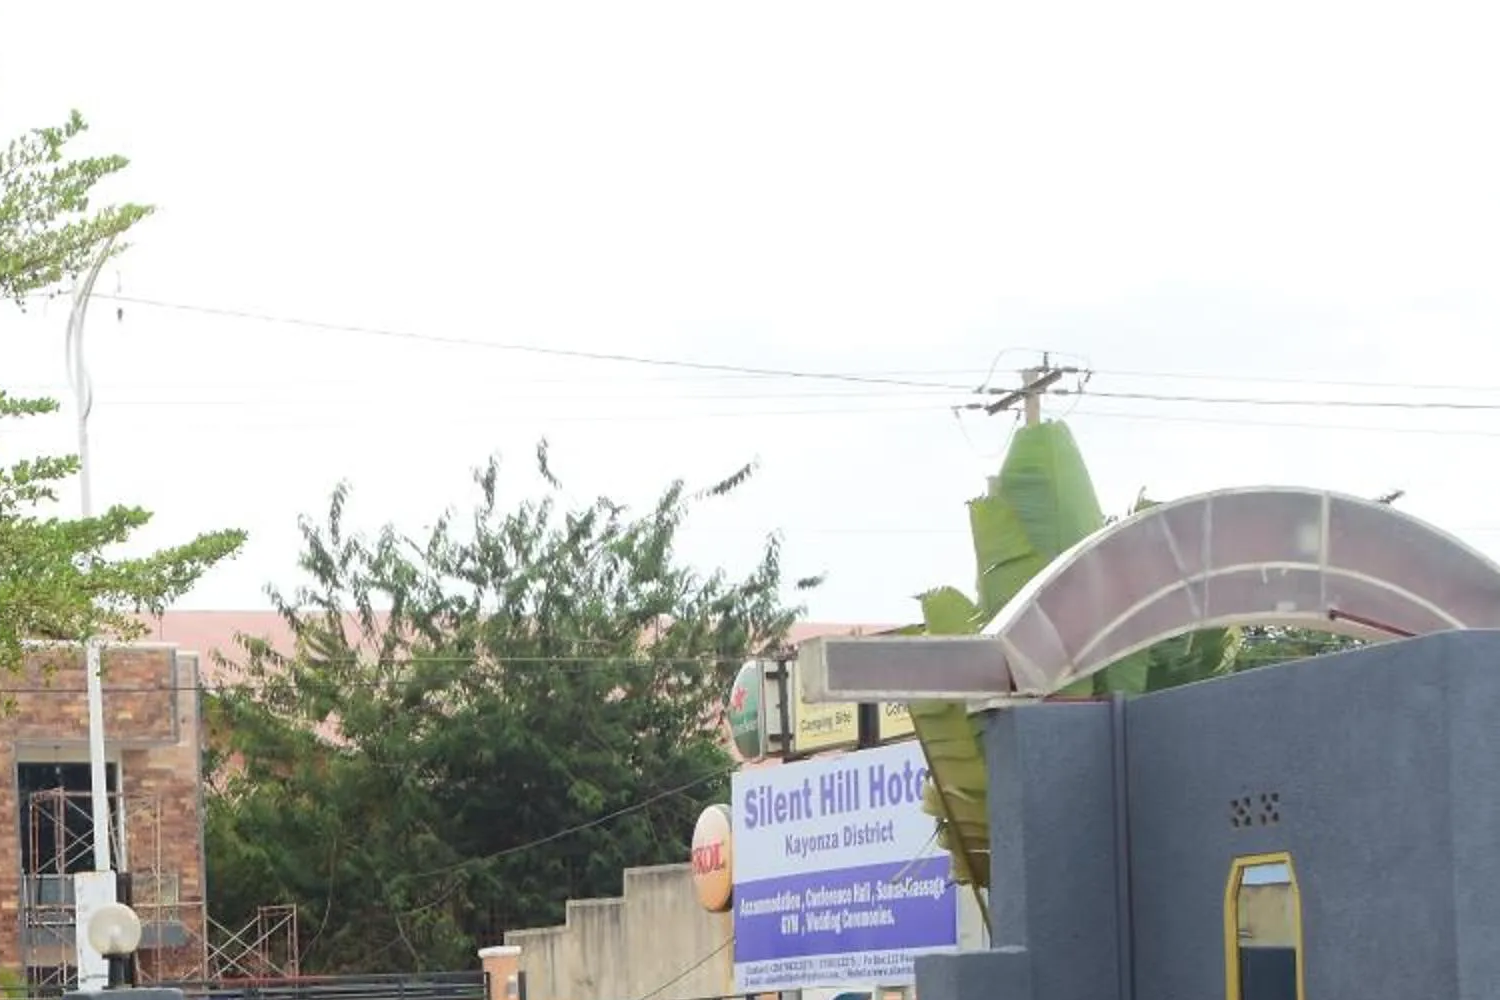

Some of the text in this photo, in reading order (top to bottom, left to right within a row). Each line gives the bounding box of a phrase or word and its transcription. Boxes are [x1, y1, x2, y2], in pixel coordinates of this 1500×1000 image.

[745, 760, 927, 830] Silent Hill Hote
[785, 820, 894, 858] Kayonza District
